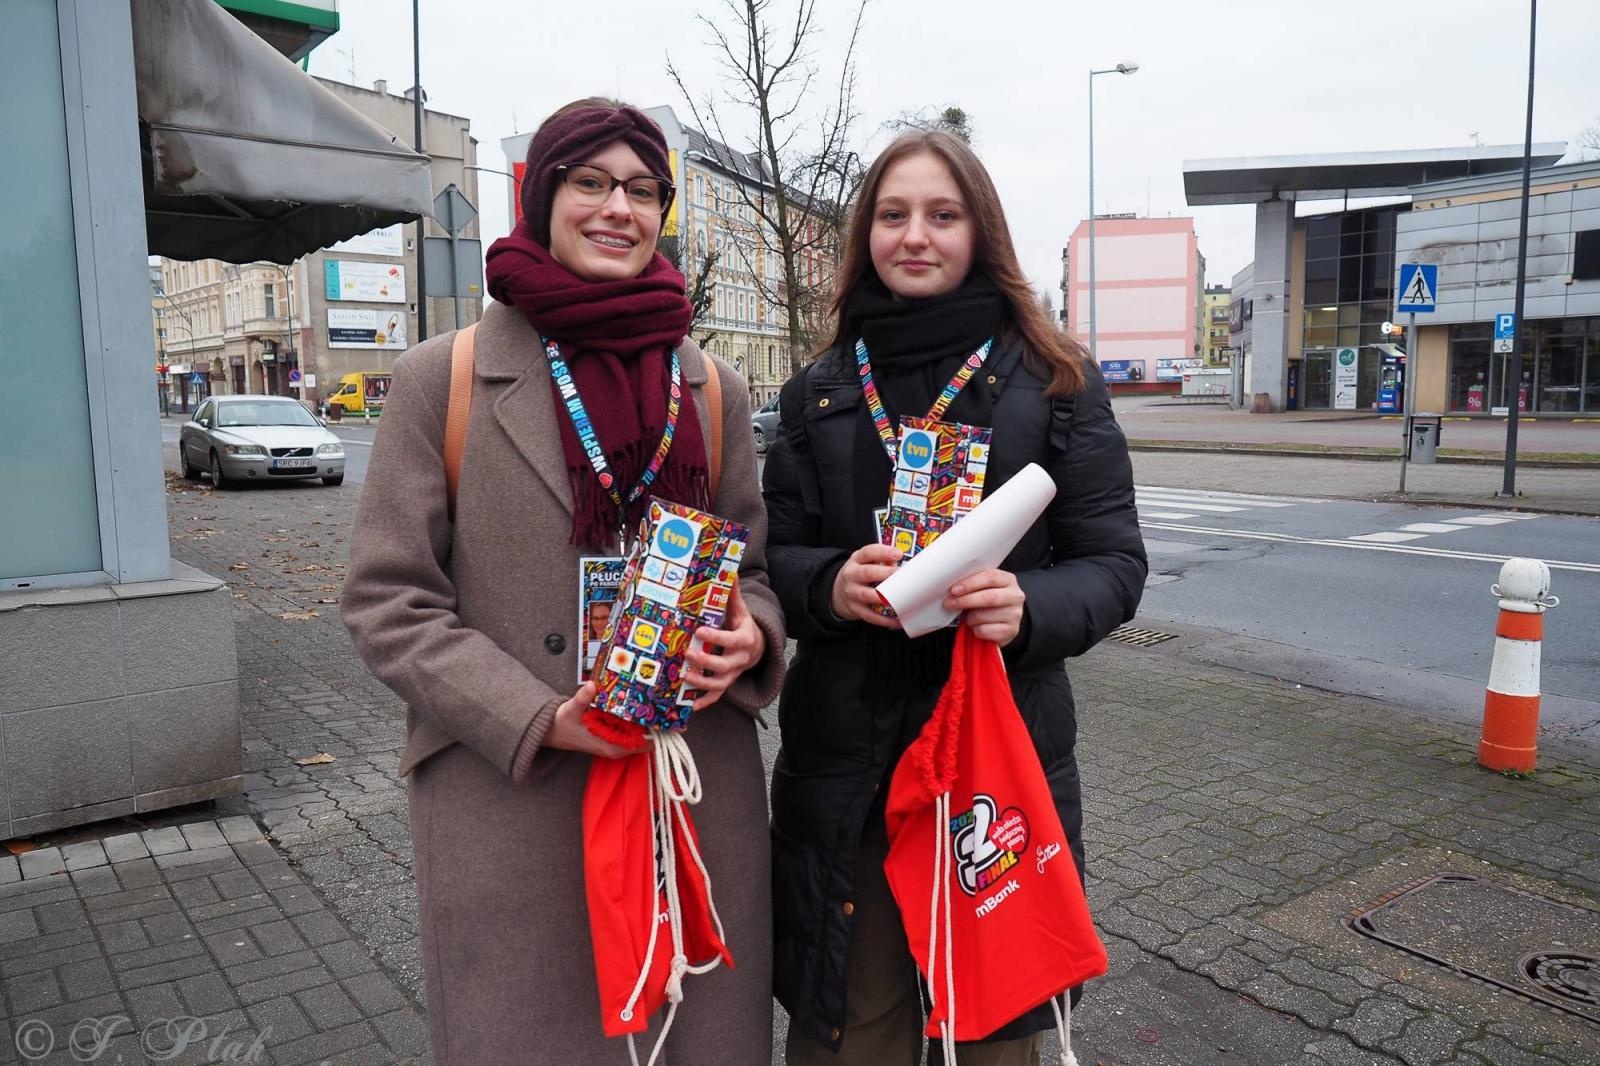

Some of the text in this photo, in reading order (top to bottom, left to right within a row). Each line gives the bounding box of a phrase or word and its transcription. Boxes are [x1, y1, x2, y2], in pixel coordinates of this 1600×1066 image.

[1500, 316, 1512, 331] P
[551, 360, 577, 400] WOŚP
[927, 391, 955, 421] ZYSTKO
[566, 398, 608, 473] WSPIERAM
[906, 442, 929, 457] tvn
[642, 470, 654, 485] TU
[663, 528, 689, 549] tvn
[975, 880, 1021, 918] mBank
